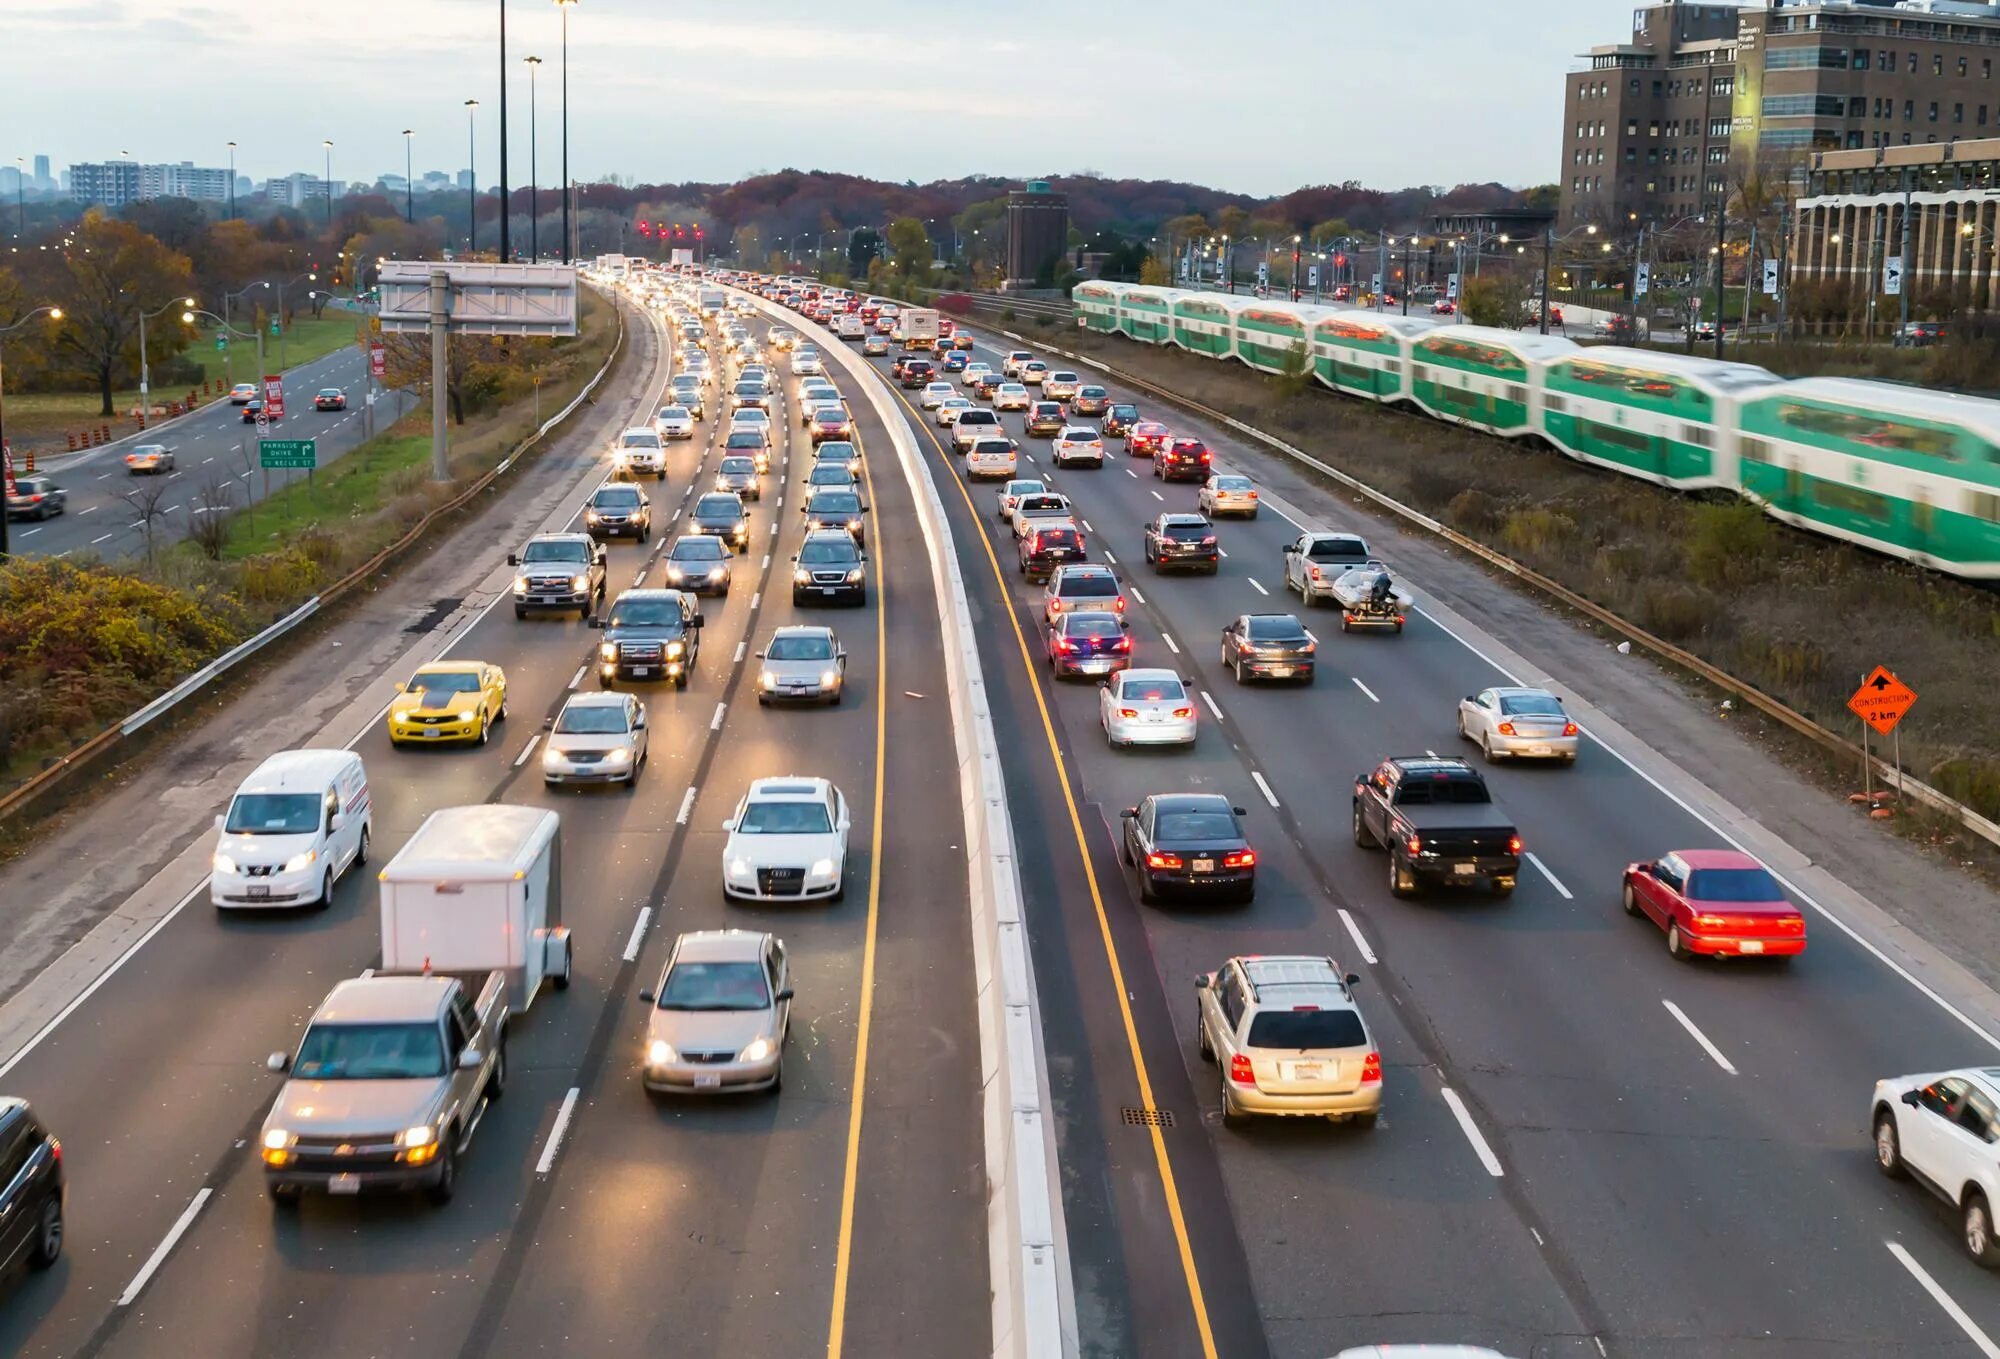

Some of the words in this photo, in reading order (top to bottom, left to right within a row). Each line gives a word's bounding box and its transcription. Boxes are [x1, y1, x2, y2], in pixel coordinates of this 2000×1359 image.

[1854, 694, 1910, 707] CONSTRUCTION
[1870, 712, 1876, 721] 2
[1880, 711, 1896, 720] km
